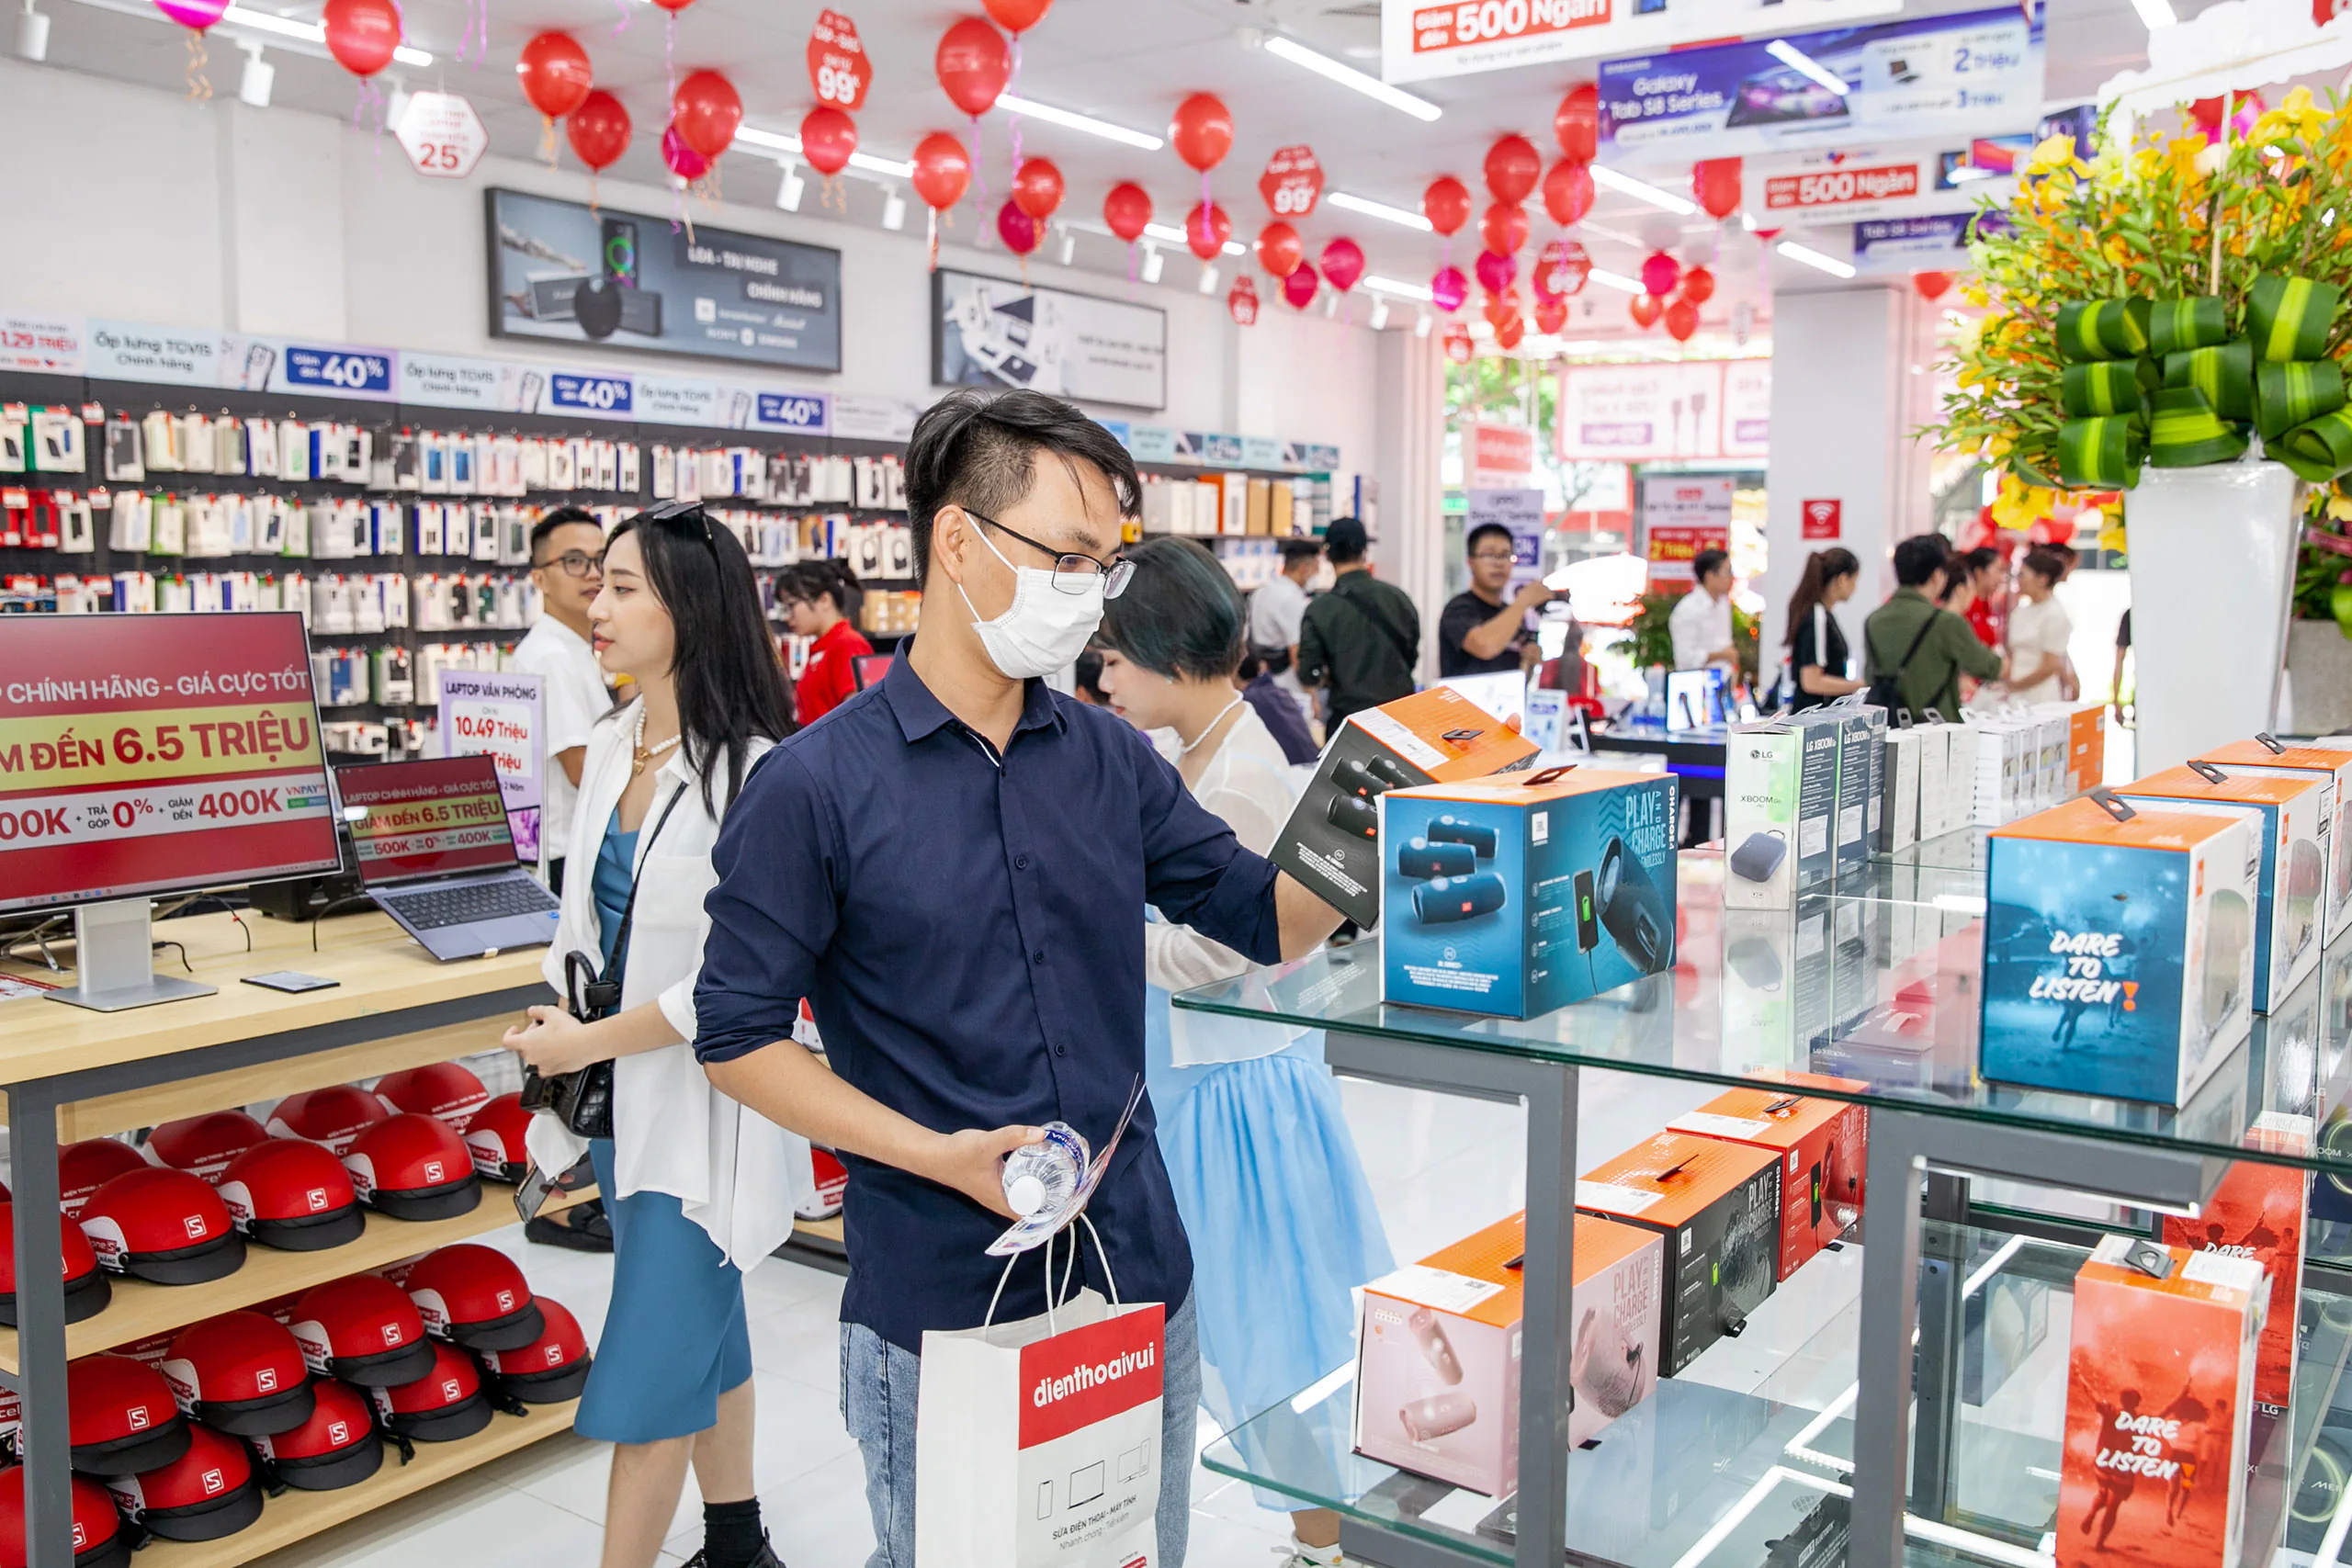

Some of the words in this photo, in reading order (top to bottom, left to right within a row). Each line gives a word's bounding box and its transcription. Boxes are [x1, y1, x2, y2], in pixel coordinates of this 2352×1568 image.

[1456, 0, 1528, 42] 500
[1954, 48, 1971, 73] 2
[1633, 73, 1699, 96] Galaxy
[1610, 99, 1643, 120] Tab
[1667, 89, 1724, 113] Series
[1799, 173, 1856, 204] 500
[321, 354, 385, 388] 40%
[579, 379, 629, 410] 40%
[7, 677, 88, 705] CHÍNH
[92, 673, 160, 700] HÃNG
[176, 670, 216, 695] GIÁ
[218, 671, 267, 697] CỰC
[269, 663, 309, 691] TỐT
[446, 682, 480, 696] LAPTOP
[481, 681, 501, 698] VĂN
[503, 683, 537, 700] PHÒNG
[29, 728, 106, 772] ĐẾN
[113, 725, 185, 764] 6.5
[190, 710, 311, 763] TRIỆU
[456, 716, 495, 739] 10.49
[497, 721, 528, 743] Triệu
[1844, 732, 1851, 745] LG
[1761, 750, 1773, 759] LG
[1805, 740, 1815, 752] LG
[1815, 739, 1833, 751] XBOOM
[112, 797, 154, 829] 0%
[198, 787, 282, 818] 400K
[392, 807, 421, 827] ĐẾN
[421, 806, 450, 823] 6.5
[451, 798, 501, 820] TRIỆU
[1625, 791, 1655, 830] PLAY
[1740, 795, 1773, 804] XBOOM
[374, 840, 412, 855] 500K
[458, 831, 493, 845] 400K
[1632, 823, 1666, 855] CHARGE
[2049, 930, 2123, 957] DARE
[2068, 956, 2102, 979] TO
[1748, 1174, 1769, 1213] PLAY
[1613, 1258, 1643, 1304] PLAY
[1613, 1286, 1648, 1329] CHARGE
[1034, 1342, 1155, 1408] dienthoaivui
[2114, 1410, 2182, 1439] DARE
[2261, 1404, 2278, 1416] LG
[2131, 1435, 2163, 1458] TO
[1052, 1525, 1068, 1540] SỬA
[1069, 1517, 1087, 1534] ĐIỆN
[1059, 1536, 1083, 1551] Nhanh
